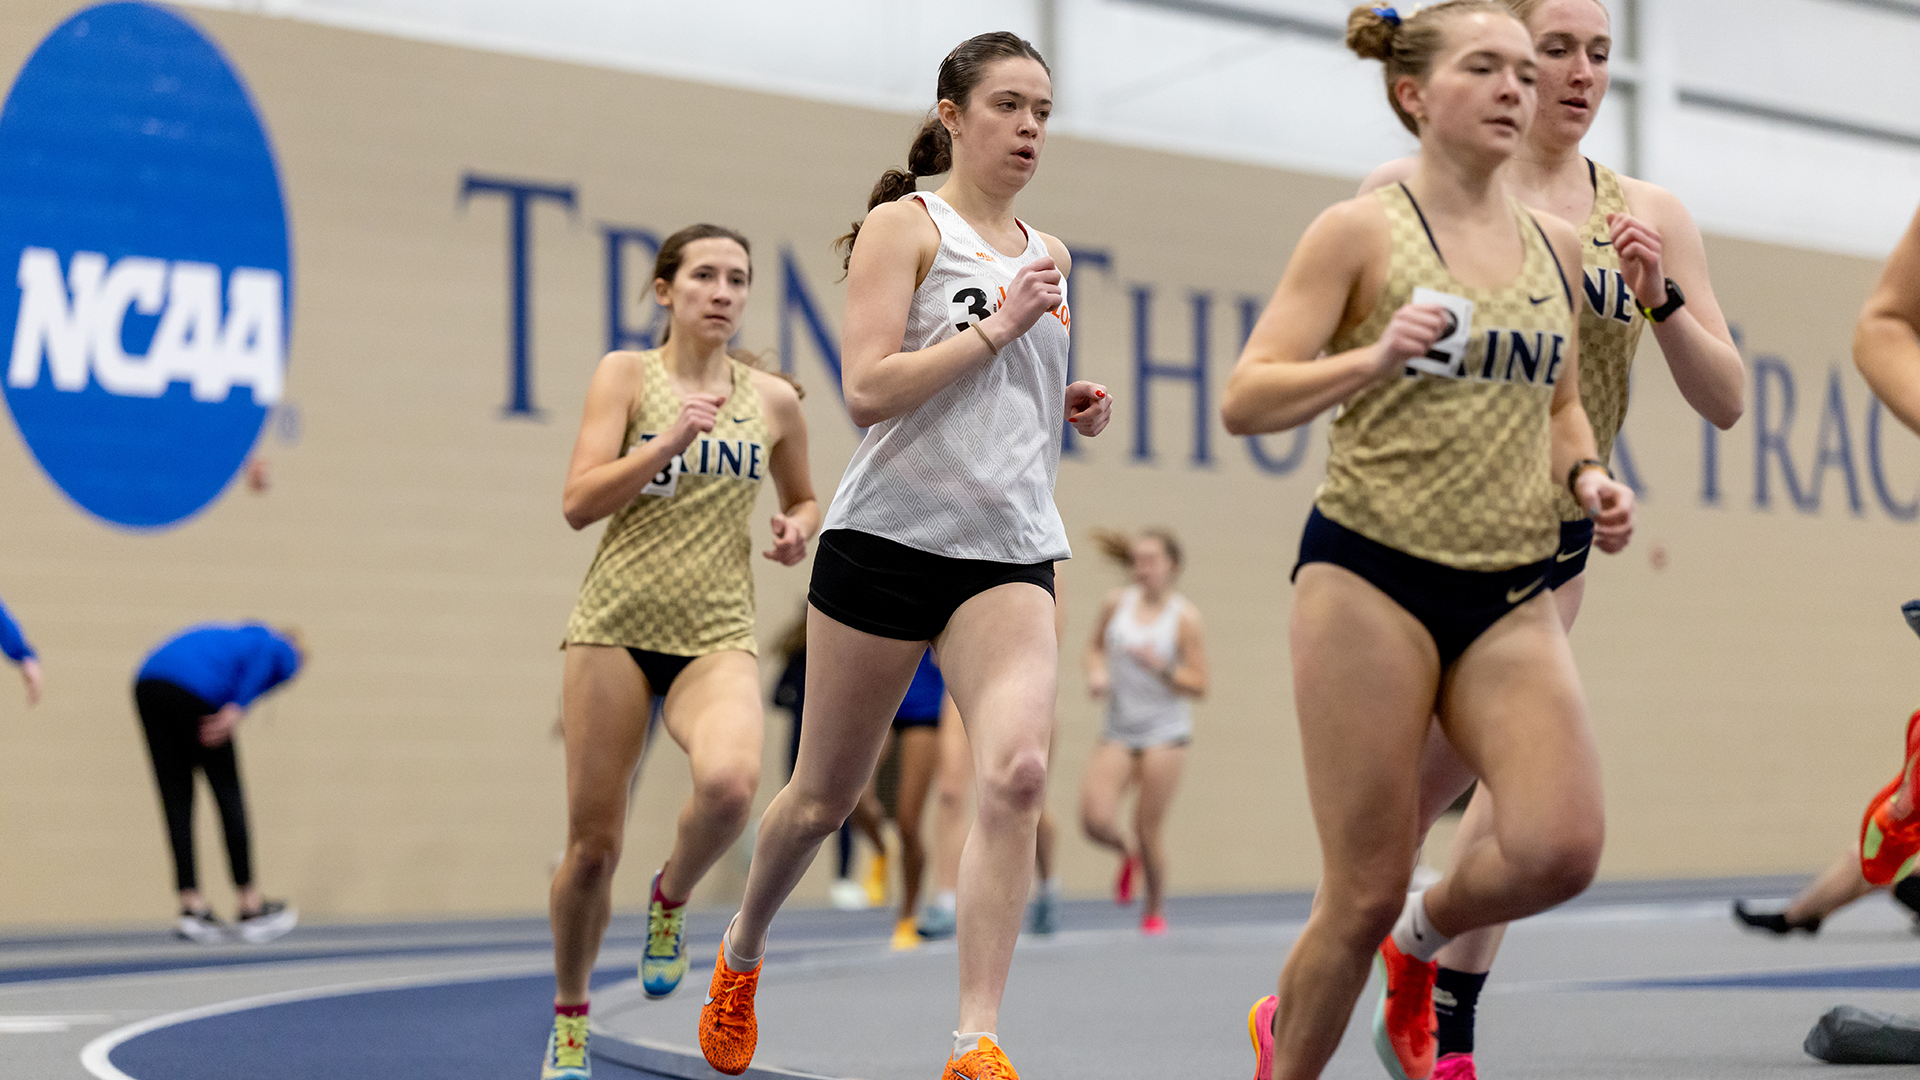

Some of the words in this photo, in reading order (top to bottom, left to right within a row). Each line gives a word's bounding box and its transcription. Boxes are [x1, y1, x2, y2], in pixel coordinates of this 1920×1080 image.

[9, 247, 284, 405] NCAA
[952, 288, 991, 331] 3
[641, 434, 760, 480] INE
